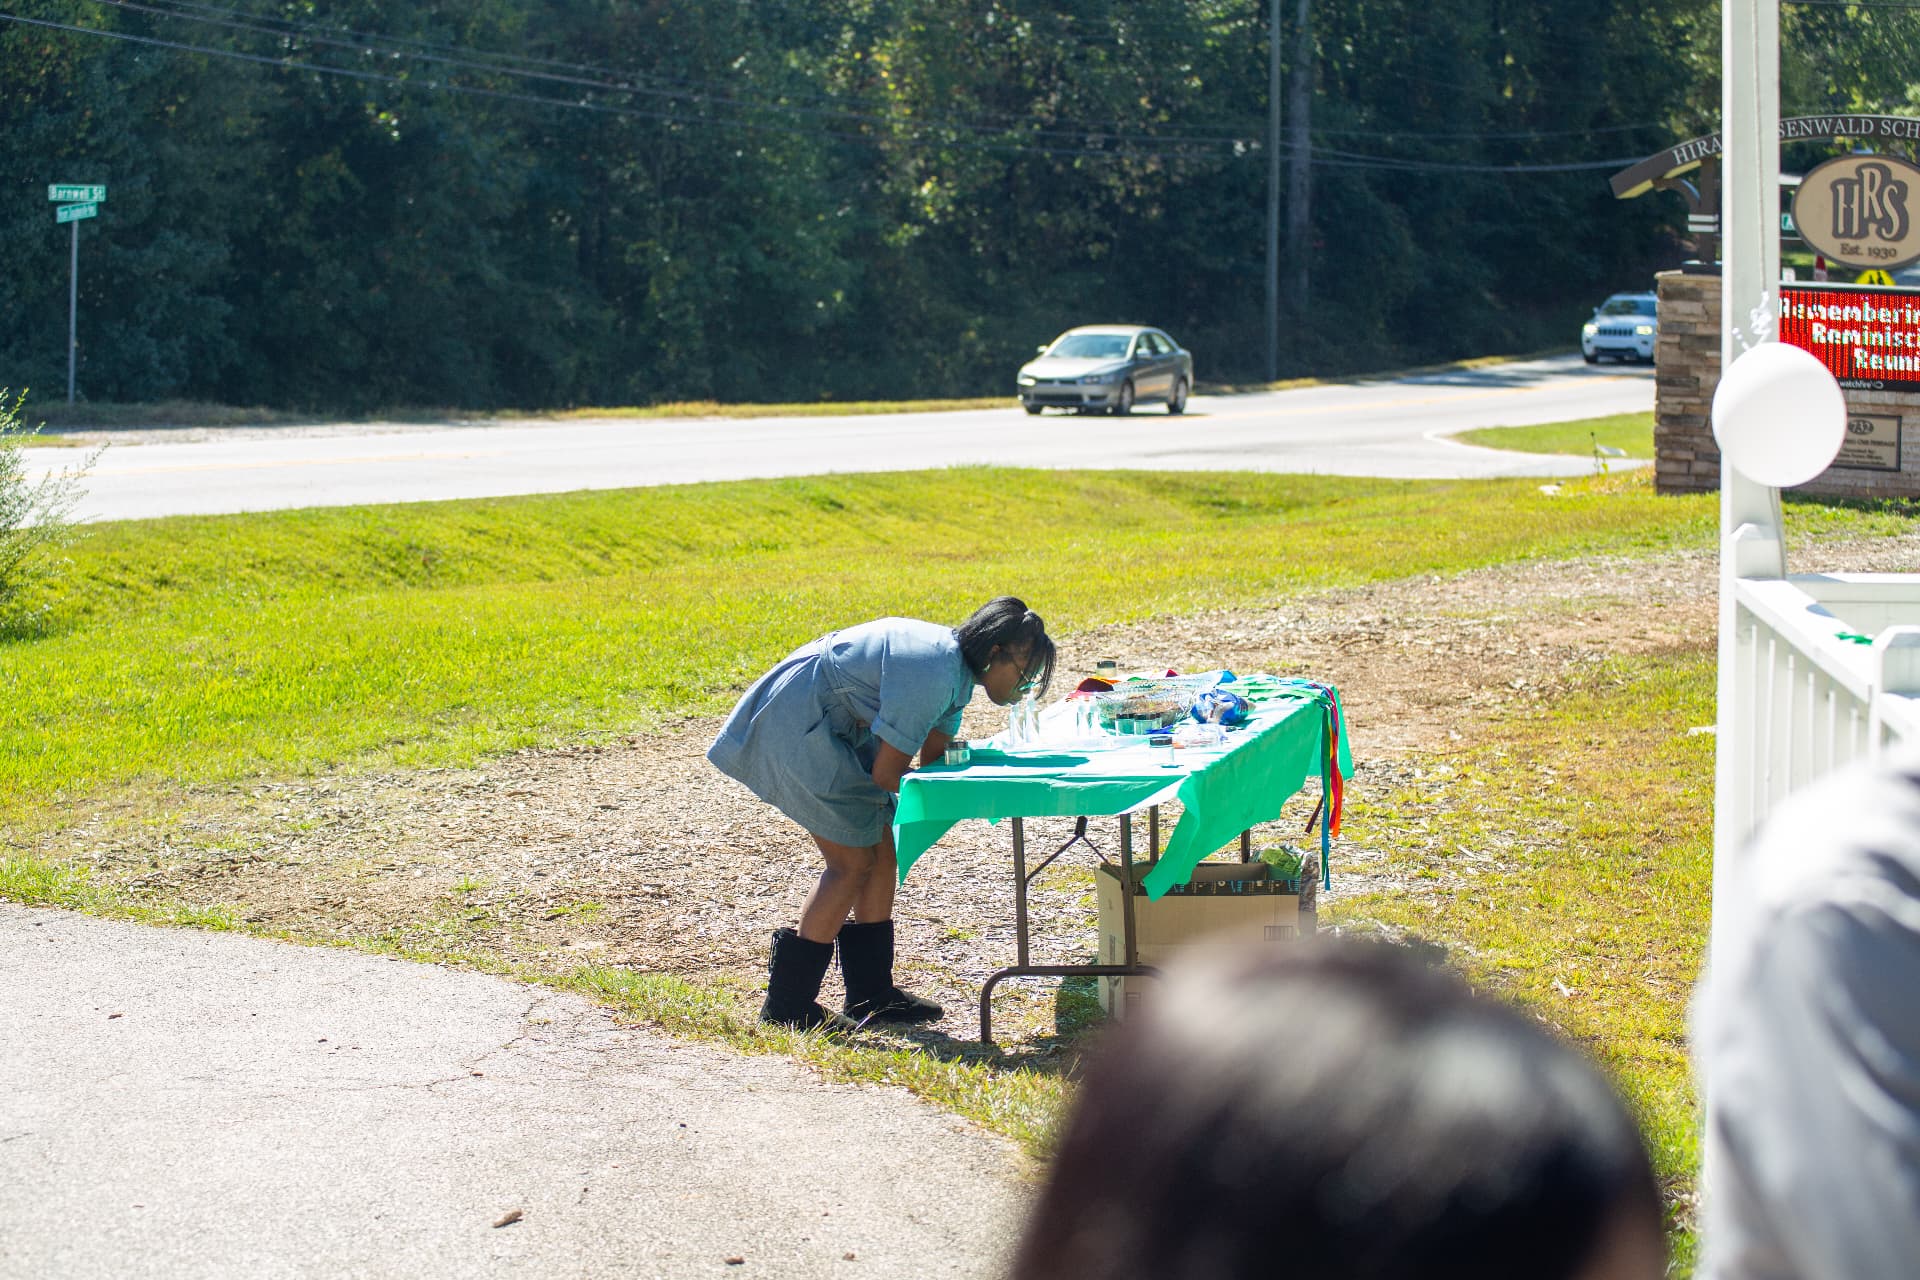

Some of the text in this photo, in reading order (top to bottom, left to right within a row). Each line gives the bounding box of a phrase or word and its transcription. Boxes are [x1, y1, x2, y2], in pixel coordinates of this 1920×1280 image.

[1672, 137, 1722, 165] HIRA
[1880, 119, 1920, 138] SCH
[1834, 166, 1903, 239] HRS
[1840, 243, 1898, 259] Est. 1930
[1851, 421, 1871, 433] 732
